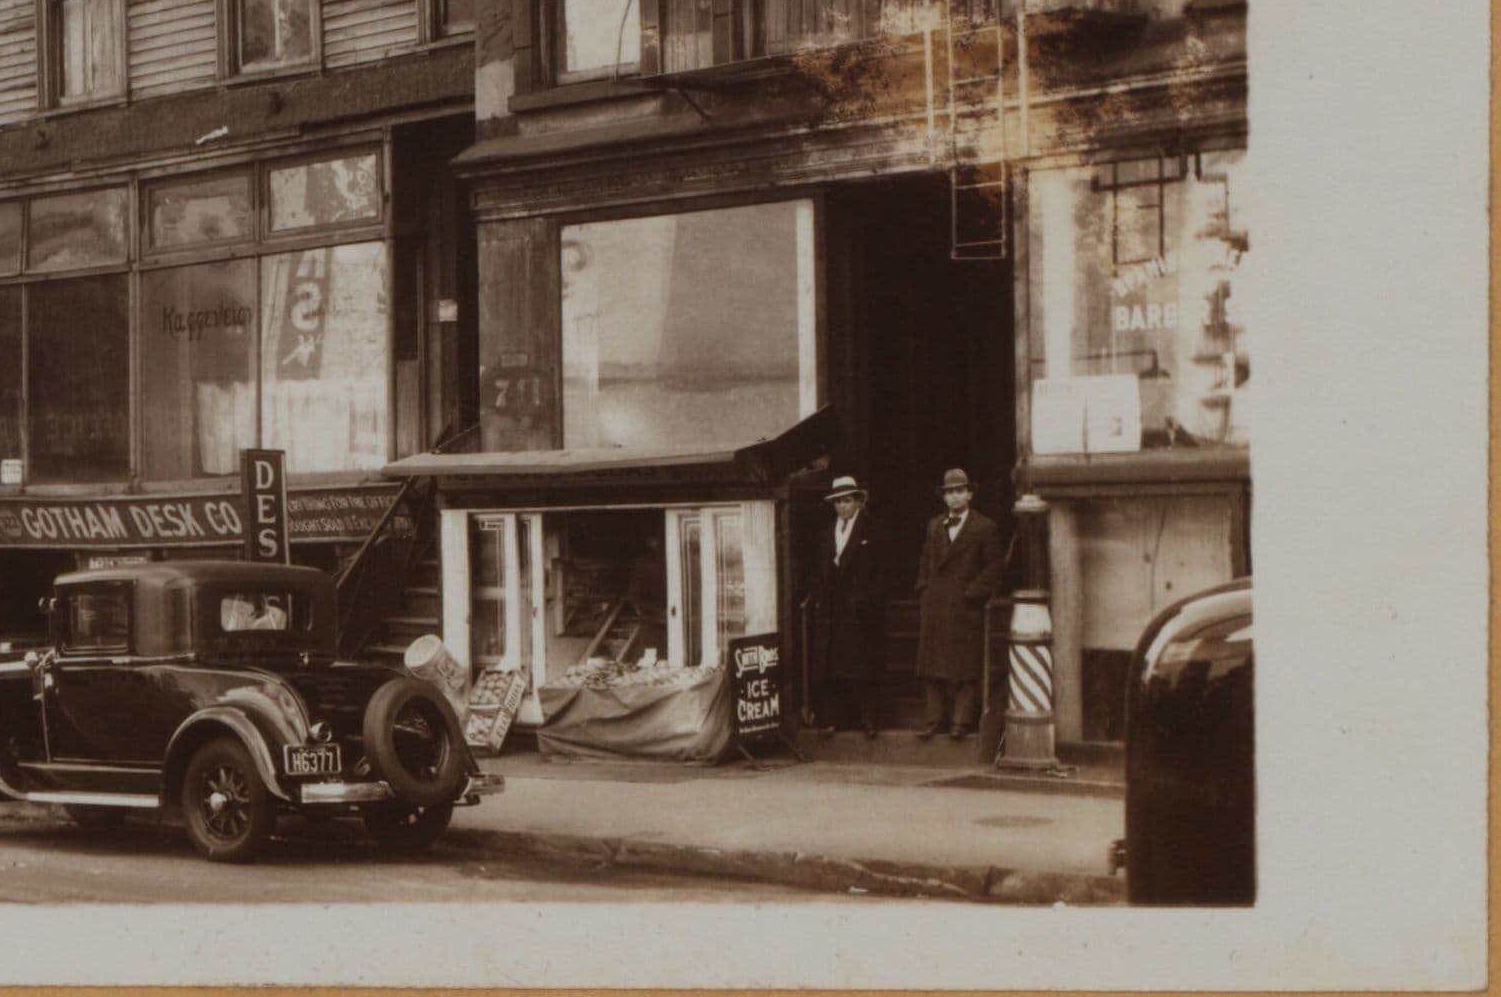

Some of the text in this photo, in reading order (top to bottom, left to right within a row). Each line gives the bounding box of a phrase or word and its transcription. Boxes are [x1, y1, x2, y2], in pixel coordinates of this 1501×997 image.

[21, 504, 128, 538] GOTHAM
[129, 503, 206, 537] DESK
[204, 502, 242, 534] CO
[747, 678, 769, 699] ICE
[737, 692, 780, 722] CREAM
[292, 752, 333, 772] H6377
